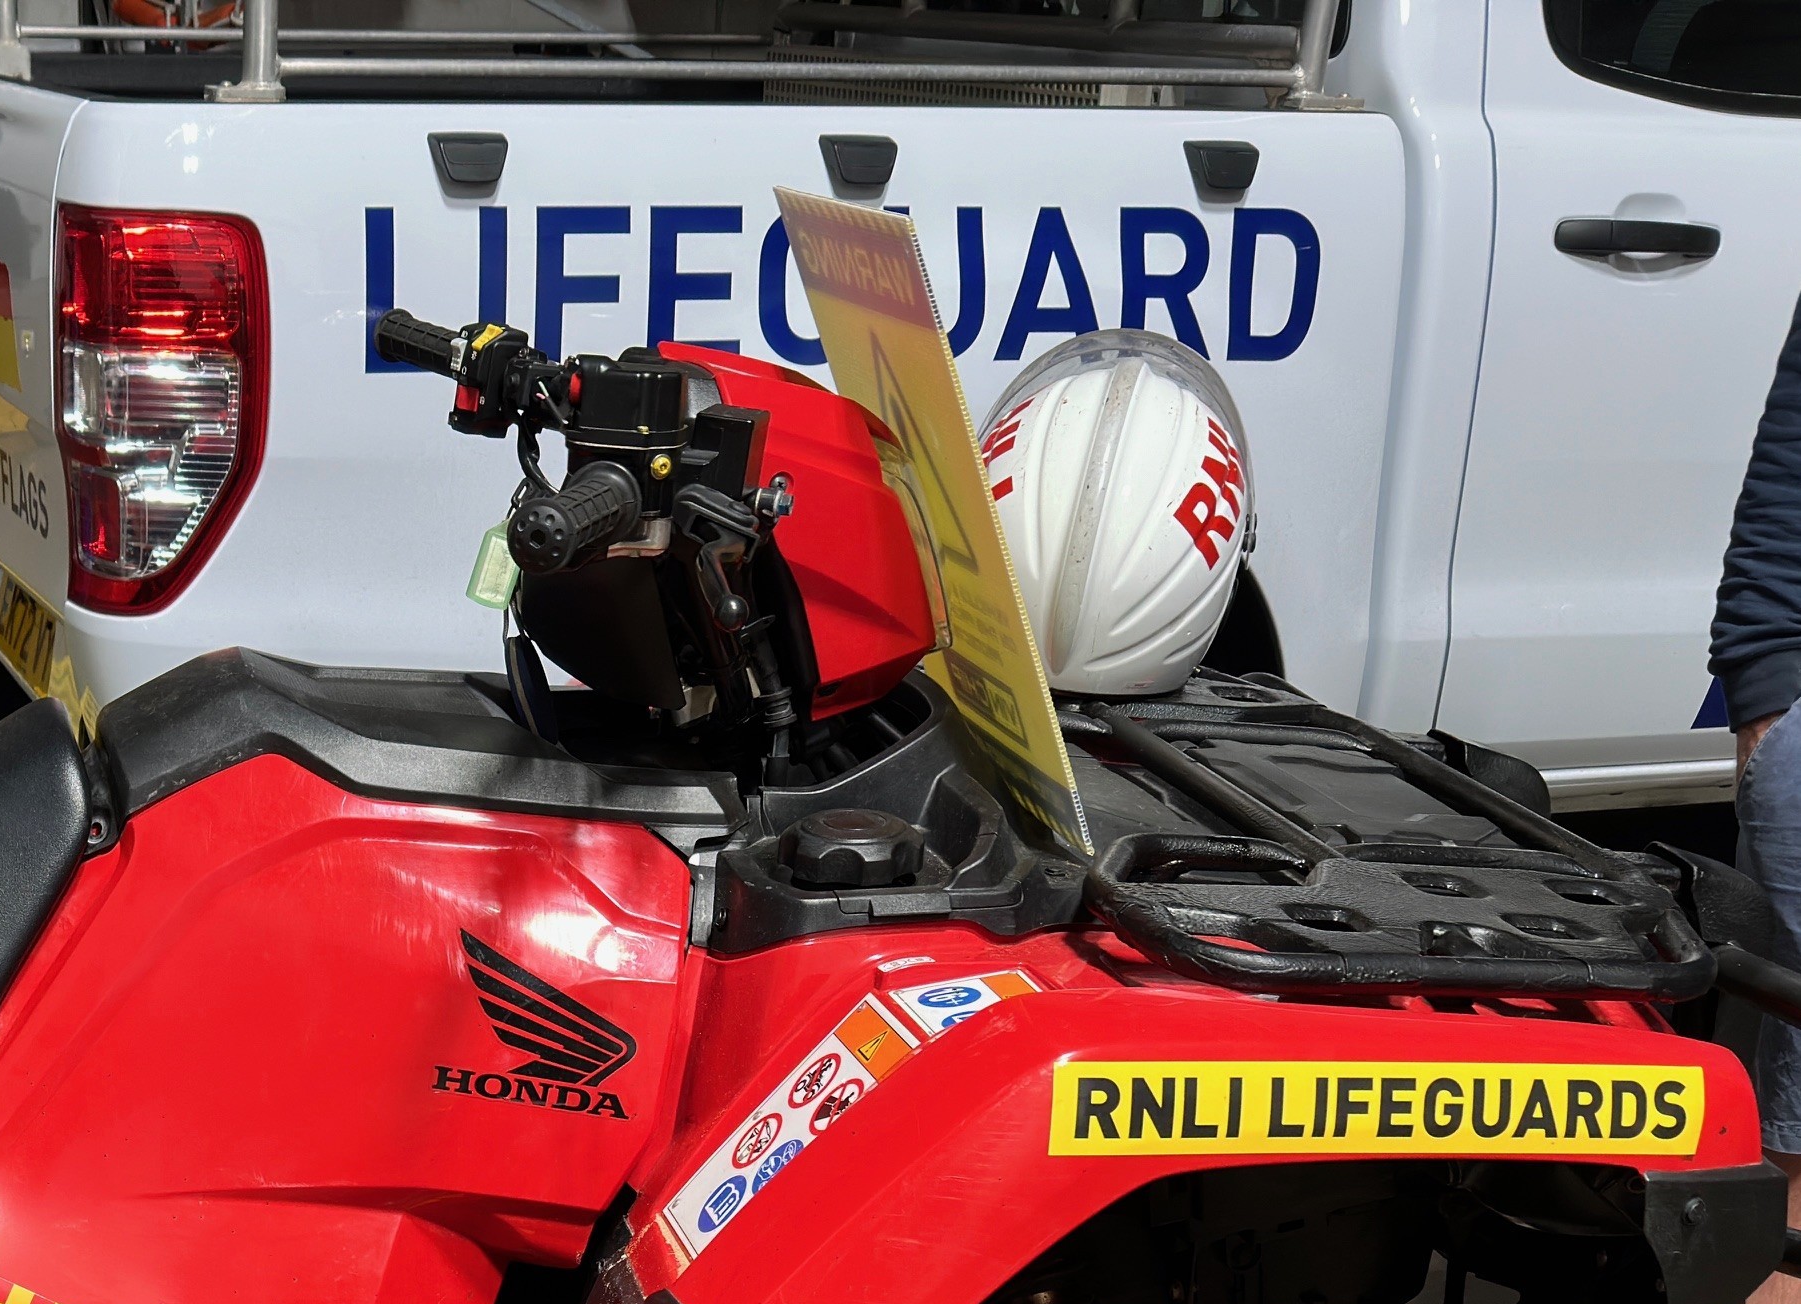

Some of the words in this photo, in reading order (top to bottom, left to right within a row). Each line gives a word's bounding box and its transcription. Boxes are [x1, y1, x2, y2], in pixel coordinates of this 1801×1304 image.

[0, 448, 49, 539] FLAGS
[434, 1066, 629, 1120] HONDA
[1073, 1076, 1243, 1140] RNLI
[1267, 1077, 1688, 1141] LIFEGUARDS
